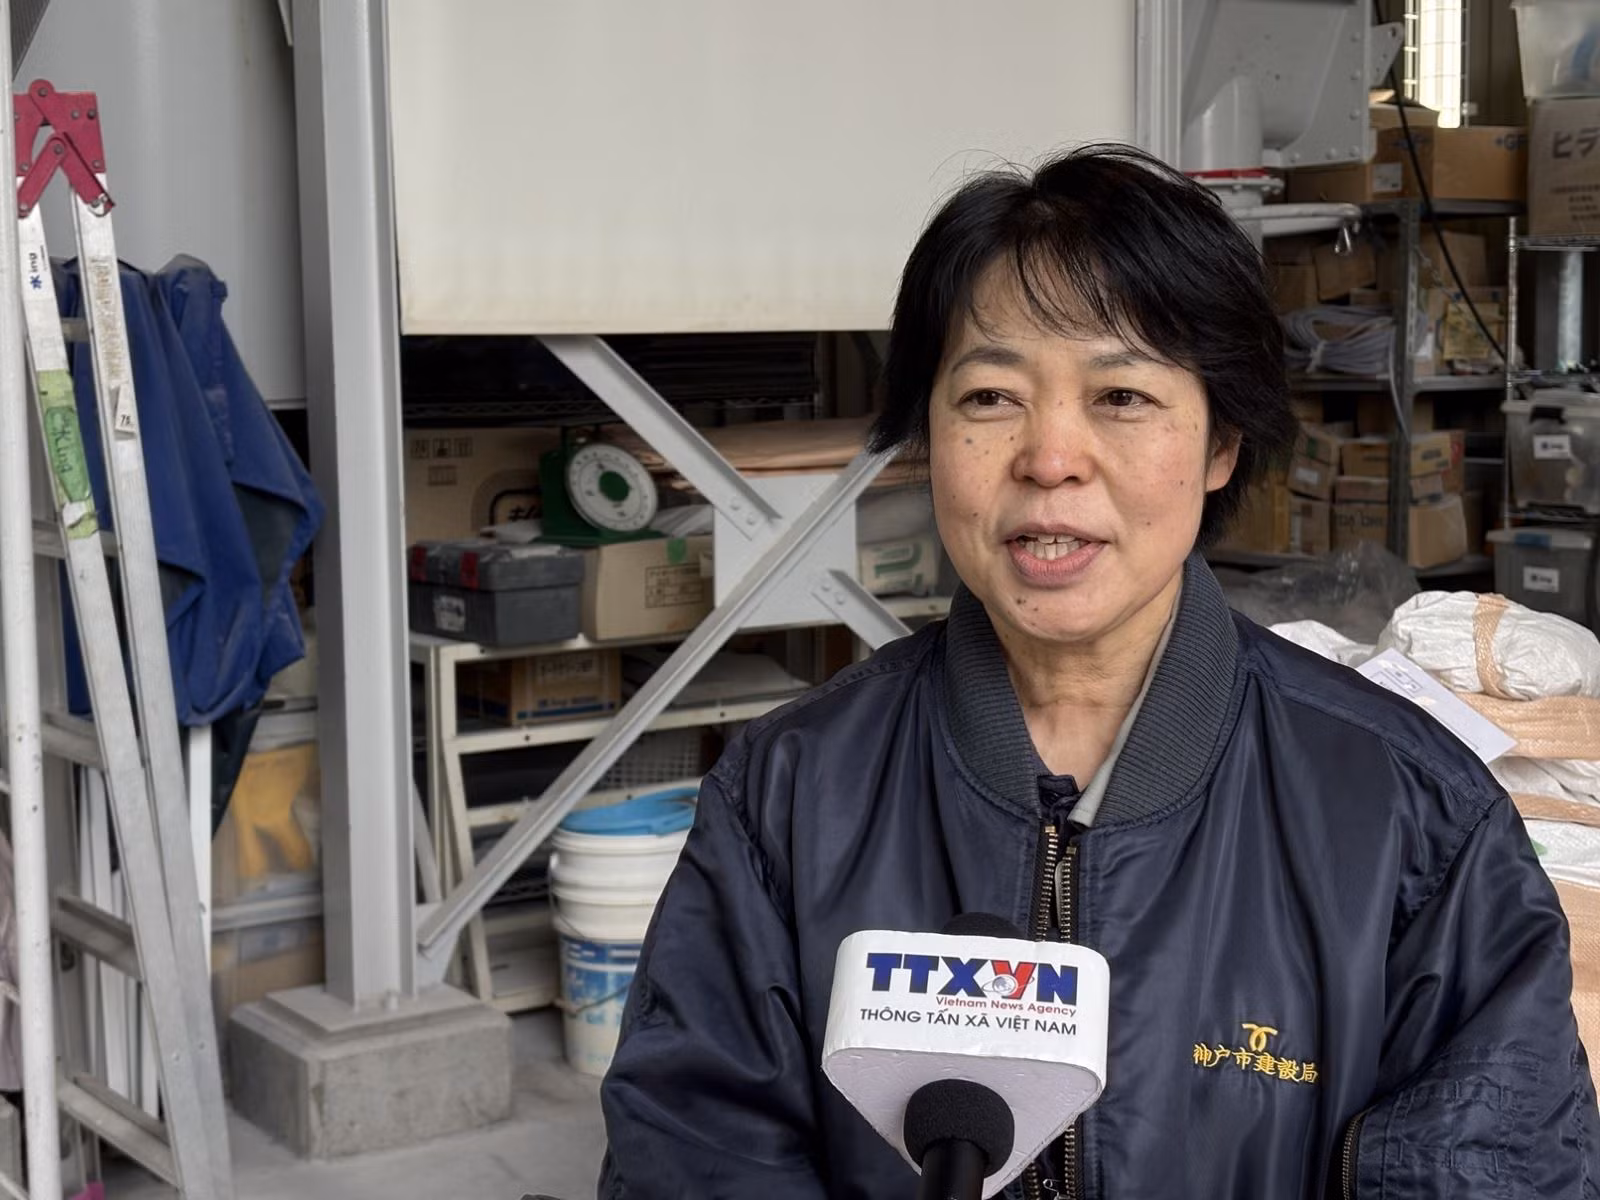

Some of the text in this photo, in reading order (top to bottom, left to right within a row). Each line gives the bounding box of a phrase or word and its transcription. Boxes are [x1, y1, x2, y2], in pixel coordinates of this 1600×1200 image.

[866, 952, 1078, 1006] TTXVN
[860, 1006, 1077, 1036] THÔNG TẤN XÃ VIỆT NAM
[936, 996, 1077, 1018] Vietnam News Agency
